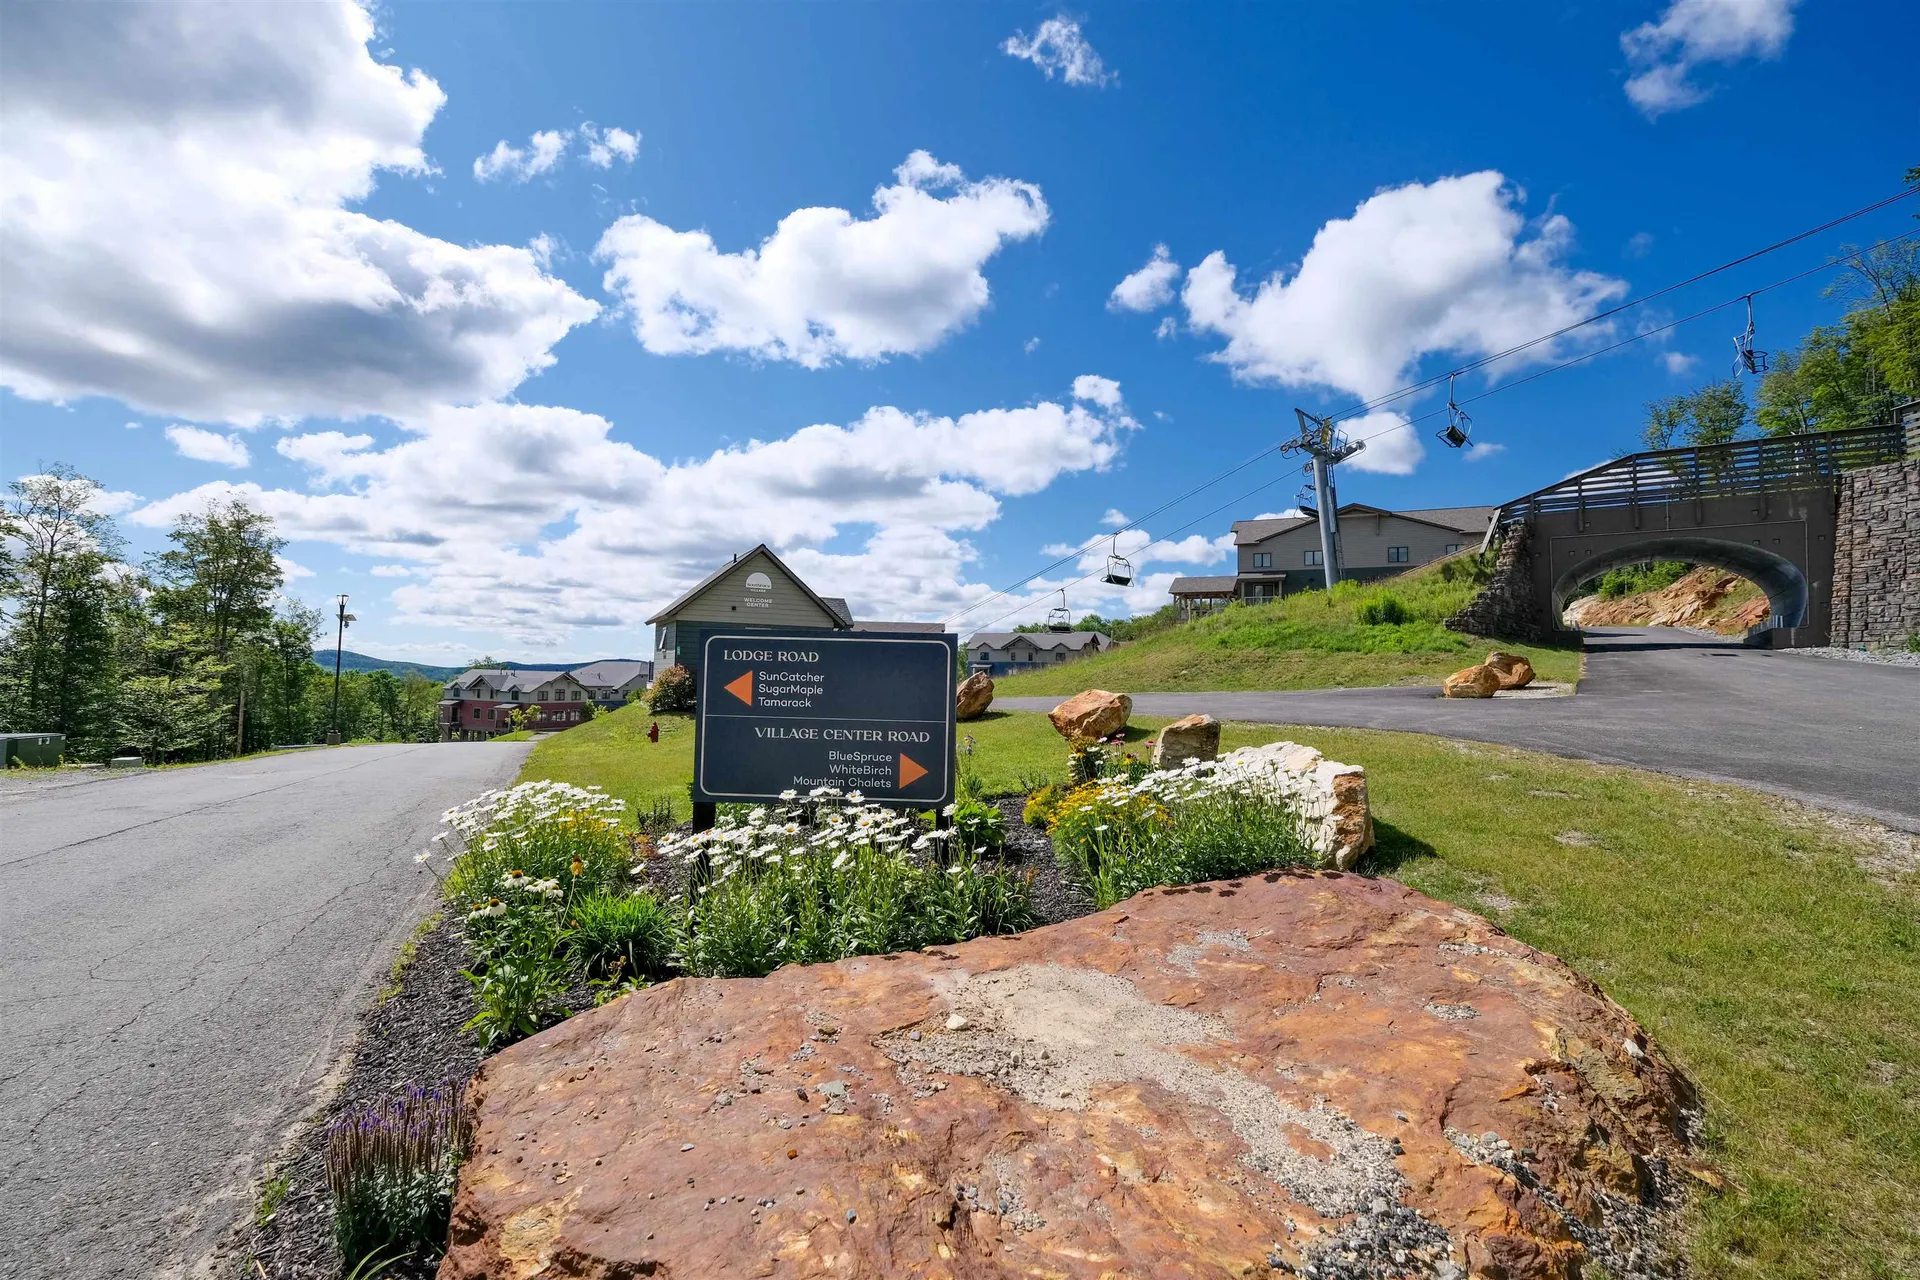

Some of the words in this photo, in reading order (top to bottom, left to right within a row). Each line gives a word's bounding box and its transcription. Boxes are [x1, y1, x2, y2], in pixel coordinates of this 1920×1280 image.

[724, 649, 773, 661] LODGE
[778, 651, 819, 663] ROAD
[759, 671, 825, 682] SunCatcher
[758, 684, 824, 697] SugarMaple
[758, 697, 812, 708] Tamarack
[755, 727, 819, 740] VILLAGE
[823, 728, 883, 742] CENTER
[888, 731, 930, 743] ROAD
[828, 751, 893, 763] BlueSpruce
[829, 764, 892, 775] WhiteBirch
[793, 776, 845, 787] Mountain
[848, 777, 892, 788] Chalets
